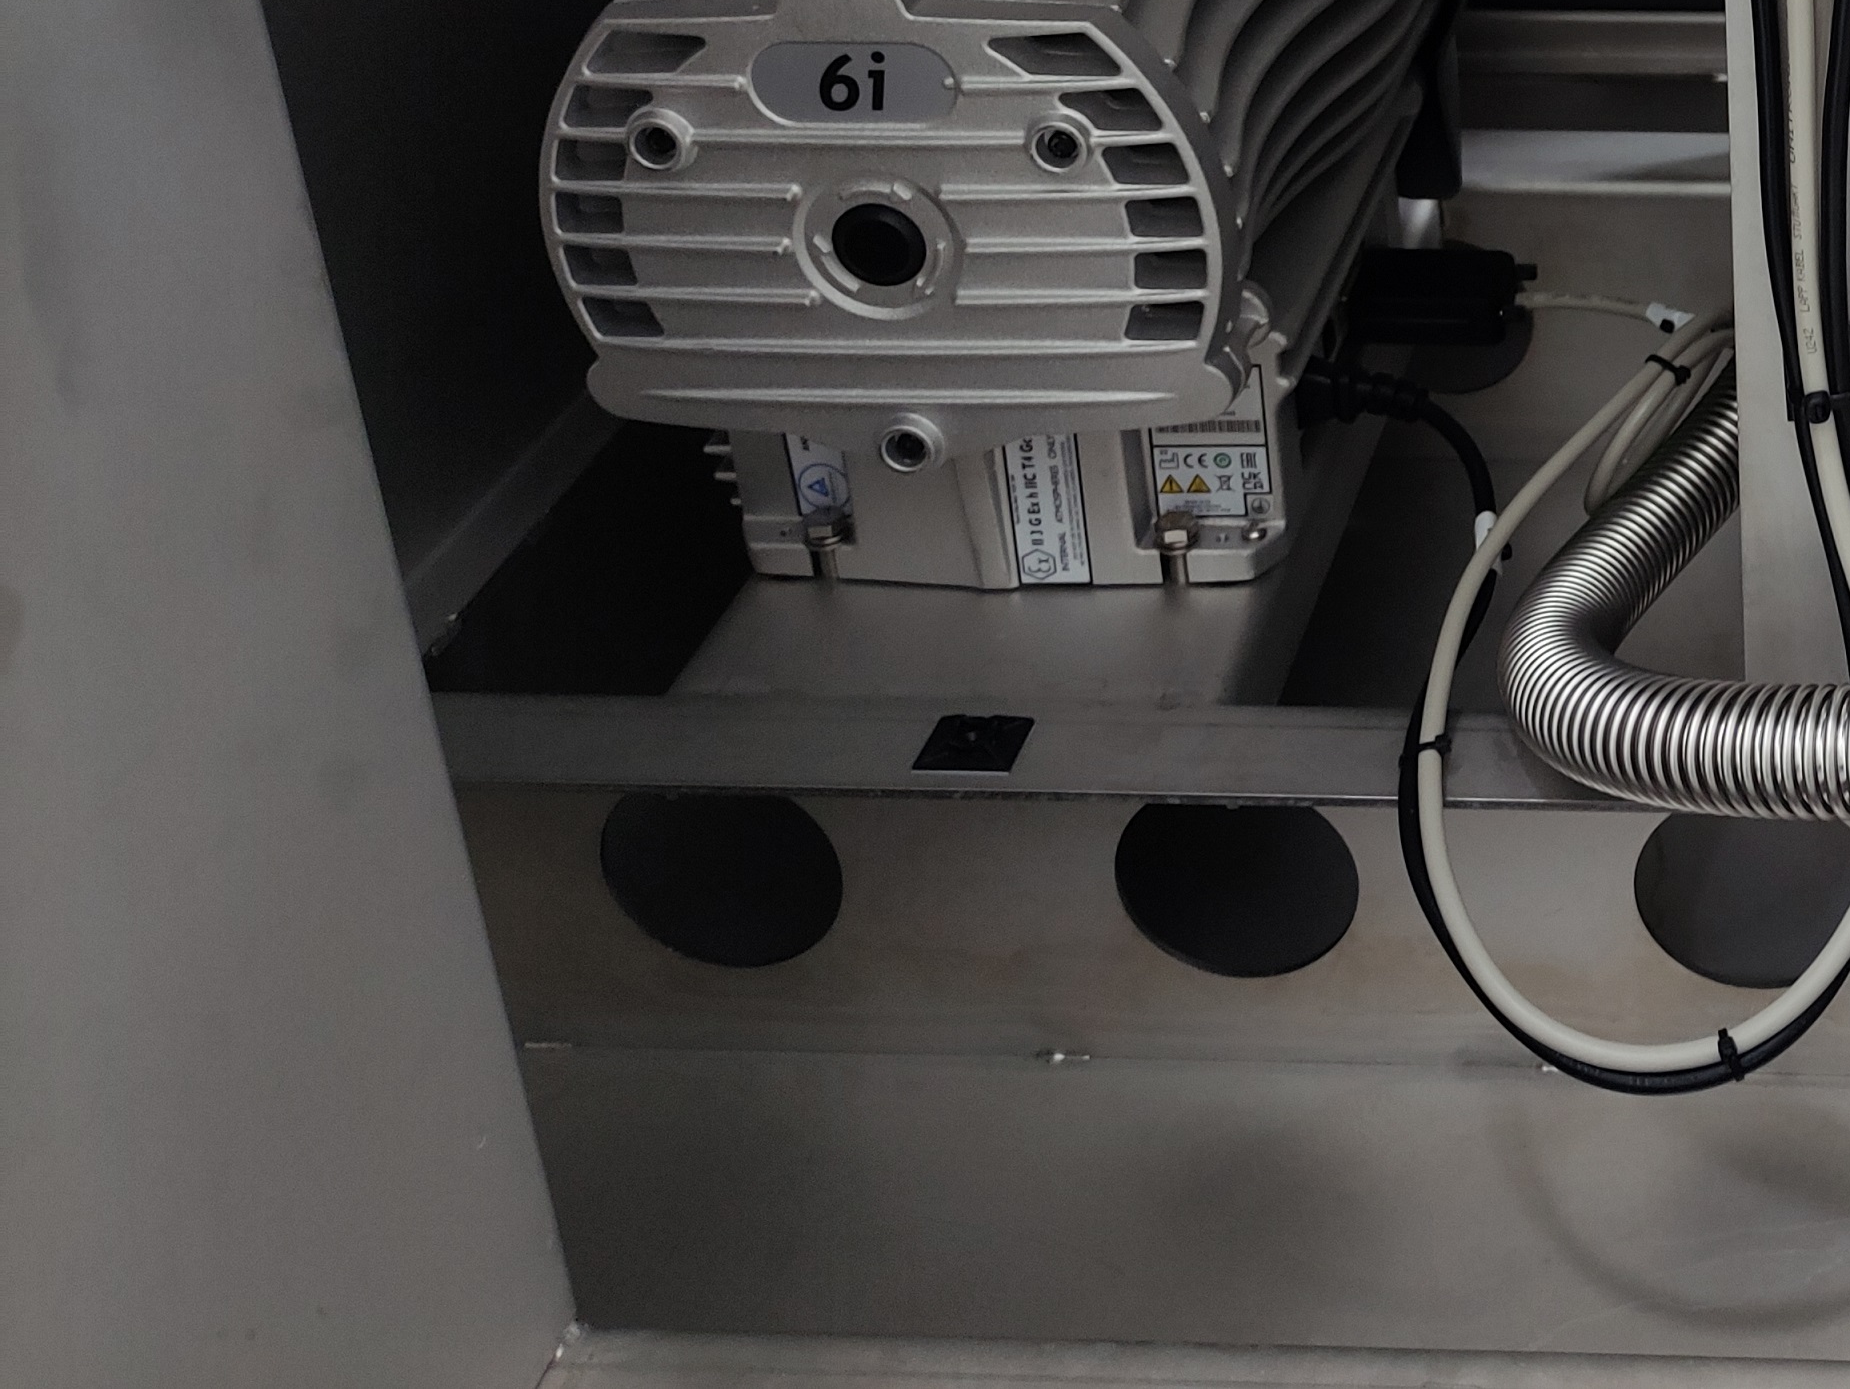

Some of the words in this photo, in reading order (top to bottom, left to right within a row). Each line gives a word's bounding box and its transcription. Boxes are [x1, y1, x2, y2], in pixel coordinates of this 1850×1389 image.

[819, 51, 885, 112] 6i
[1027, 502, 1041, 514] Ex
[1029, 518, 1042, 526] G
